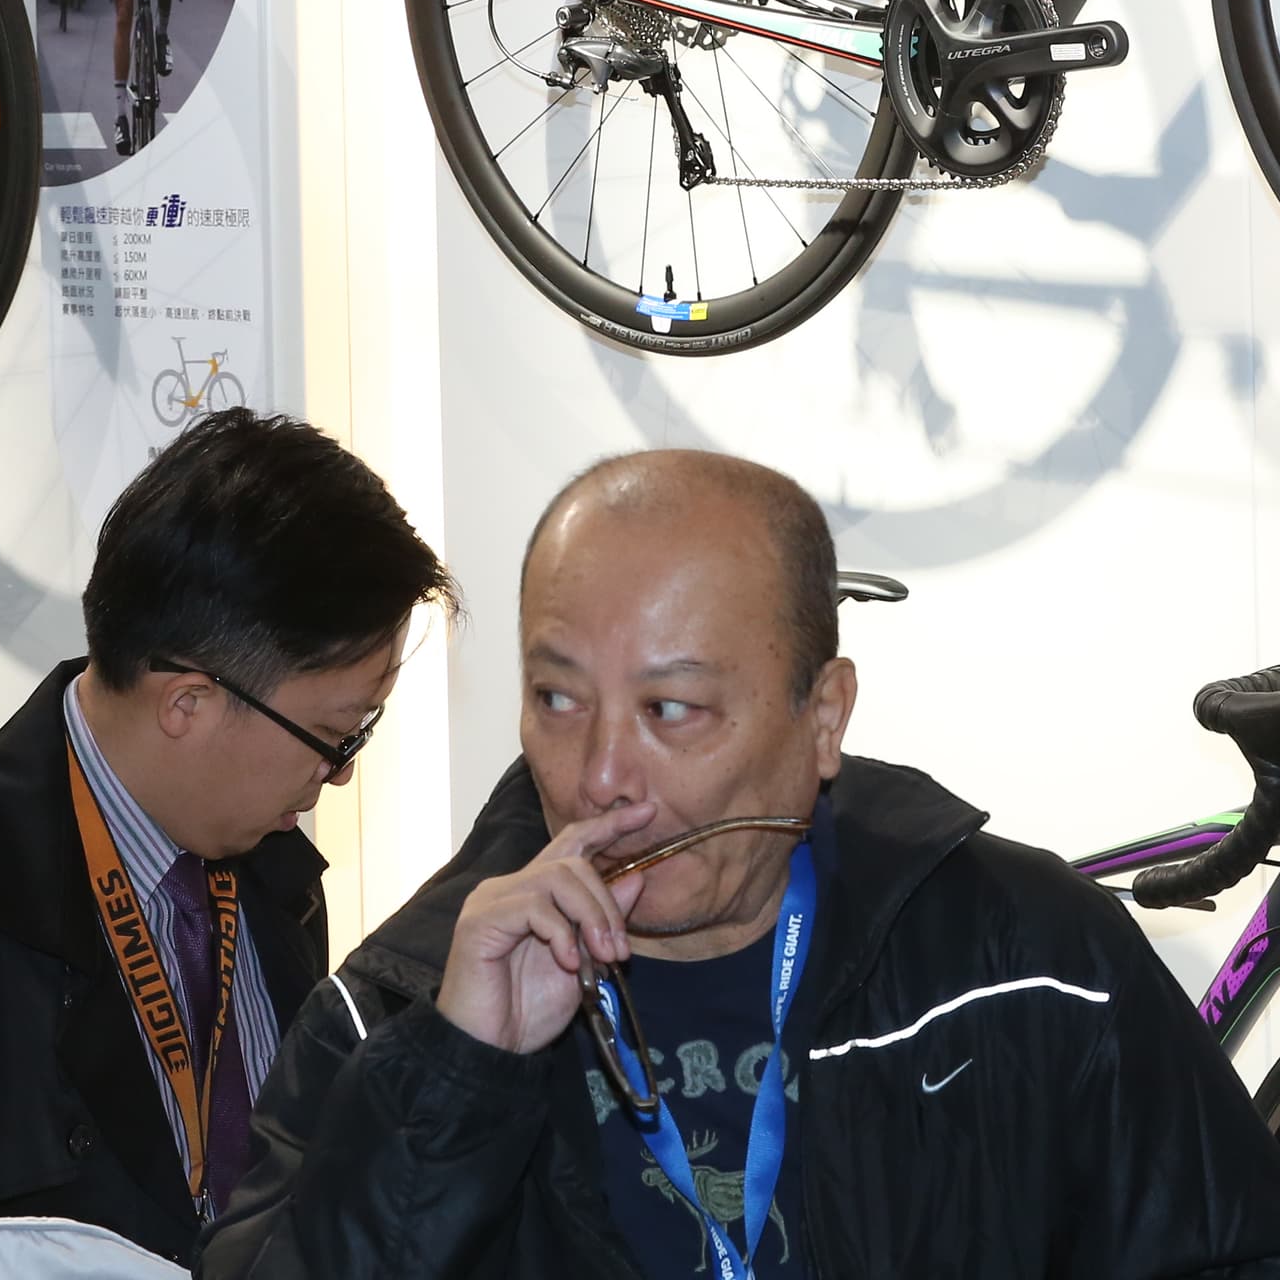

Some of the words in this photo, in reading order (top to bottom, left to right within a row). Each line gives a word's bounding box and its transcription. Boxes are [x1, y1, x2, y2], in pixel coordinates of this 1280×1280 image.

[947, 43, 1012, 61] ULTEGRA
[123, 233, 152, 245] 200KM
[124, 251, 147, 263] 150M
[124, 269, 148, 281] 60KM
[783, 913, 803, 958] GIANT.
[97, 868, 190, 1075] DIGITIMES
[779, 958, 795, 991] RIDE
